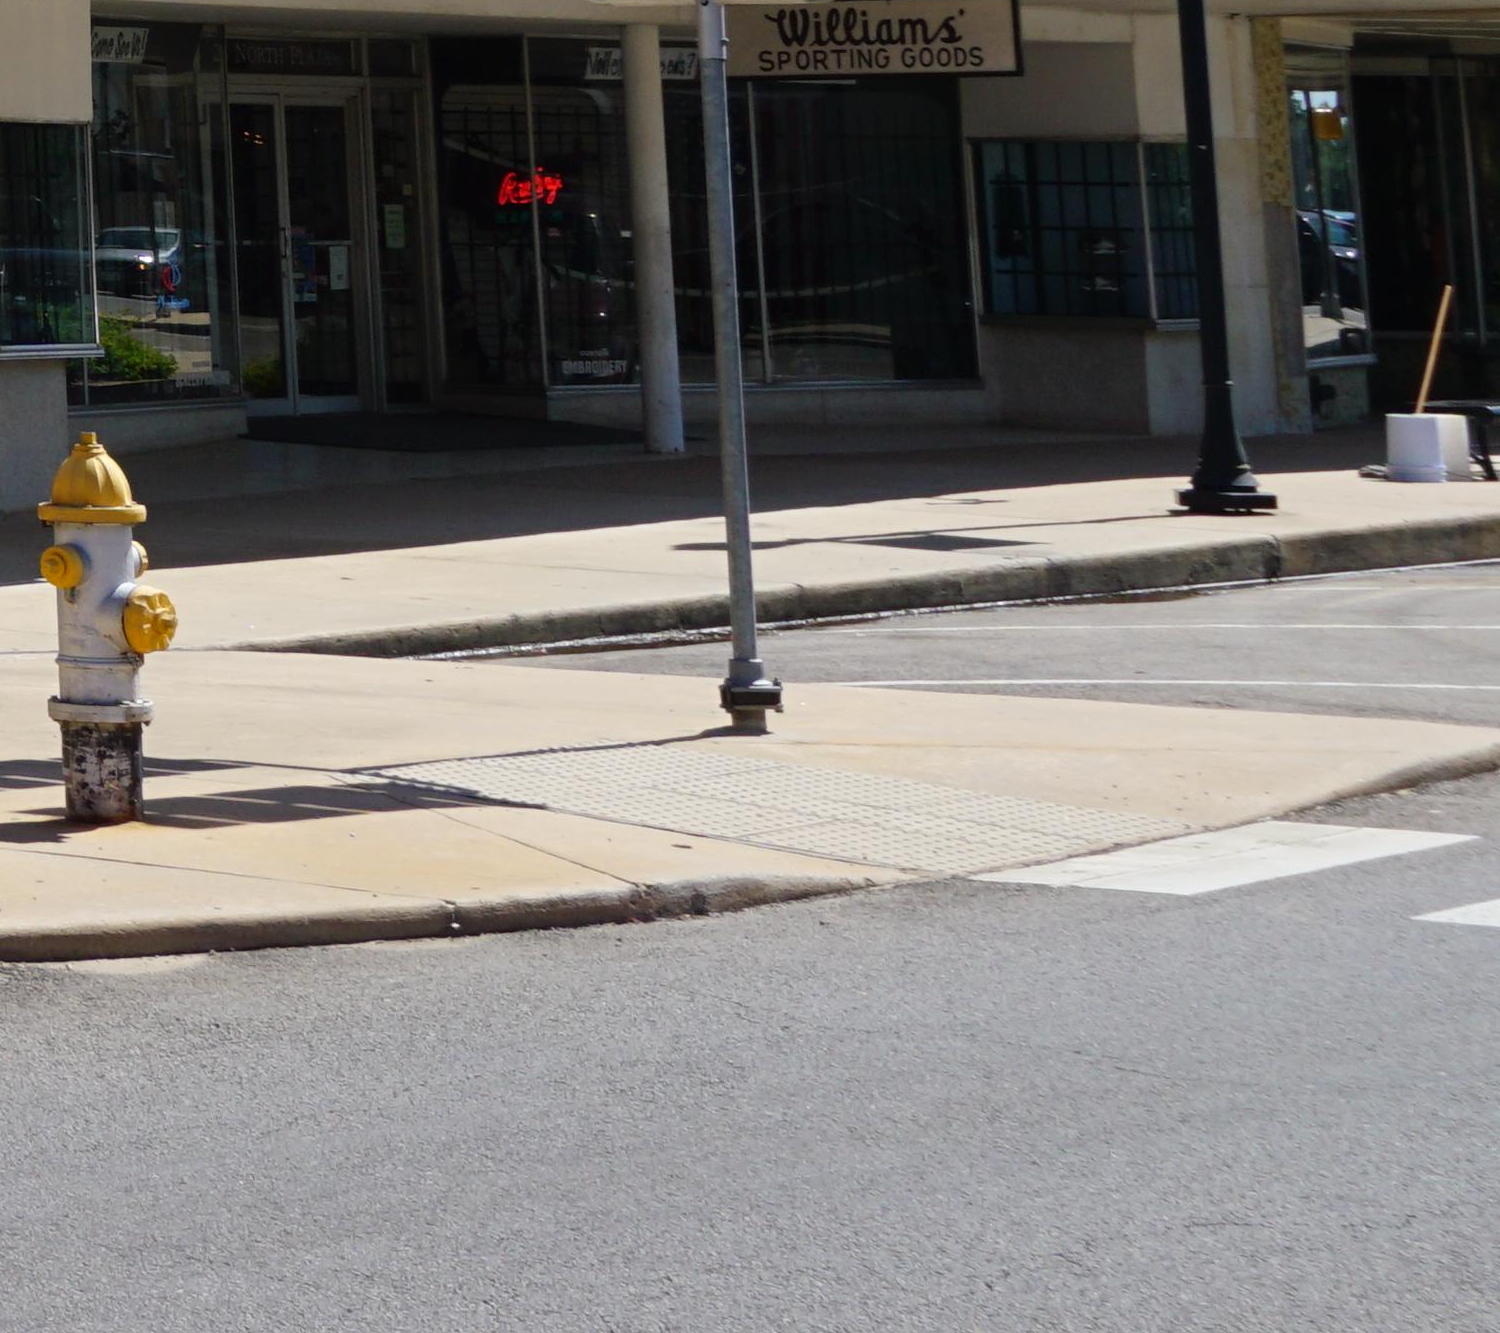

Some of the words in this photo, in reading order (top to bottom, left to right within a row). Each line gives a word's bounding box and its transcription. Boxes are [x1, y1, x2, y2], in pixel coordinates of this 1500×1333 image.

[235, 42, 284, 69] NORTH
[758, 47, 891, 73] SPORTING
[901, 45, 985, 69] GOODS
[561, 359, 628, 374] EMBROIDERY
